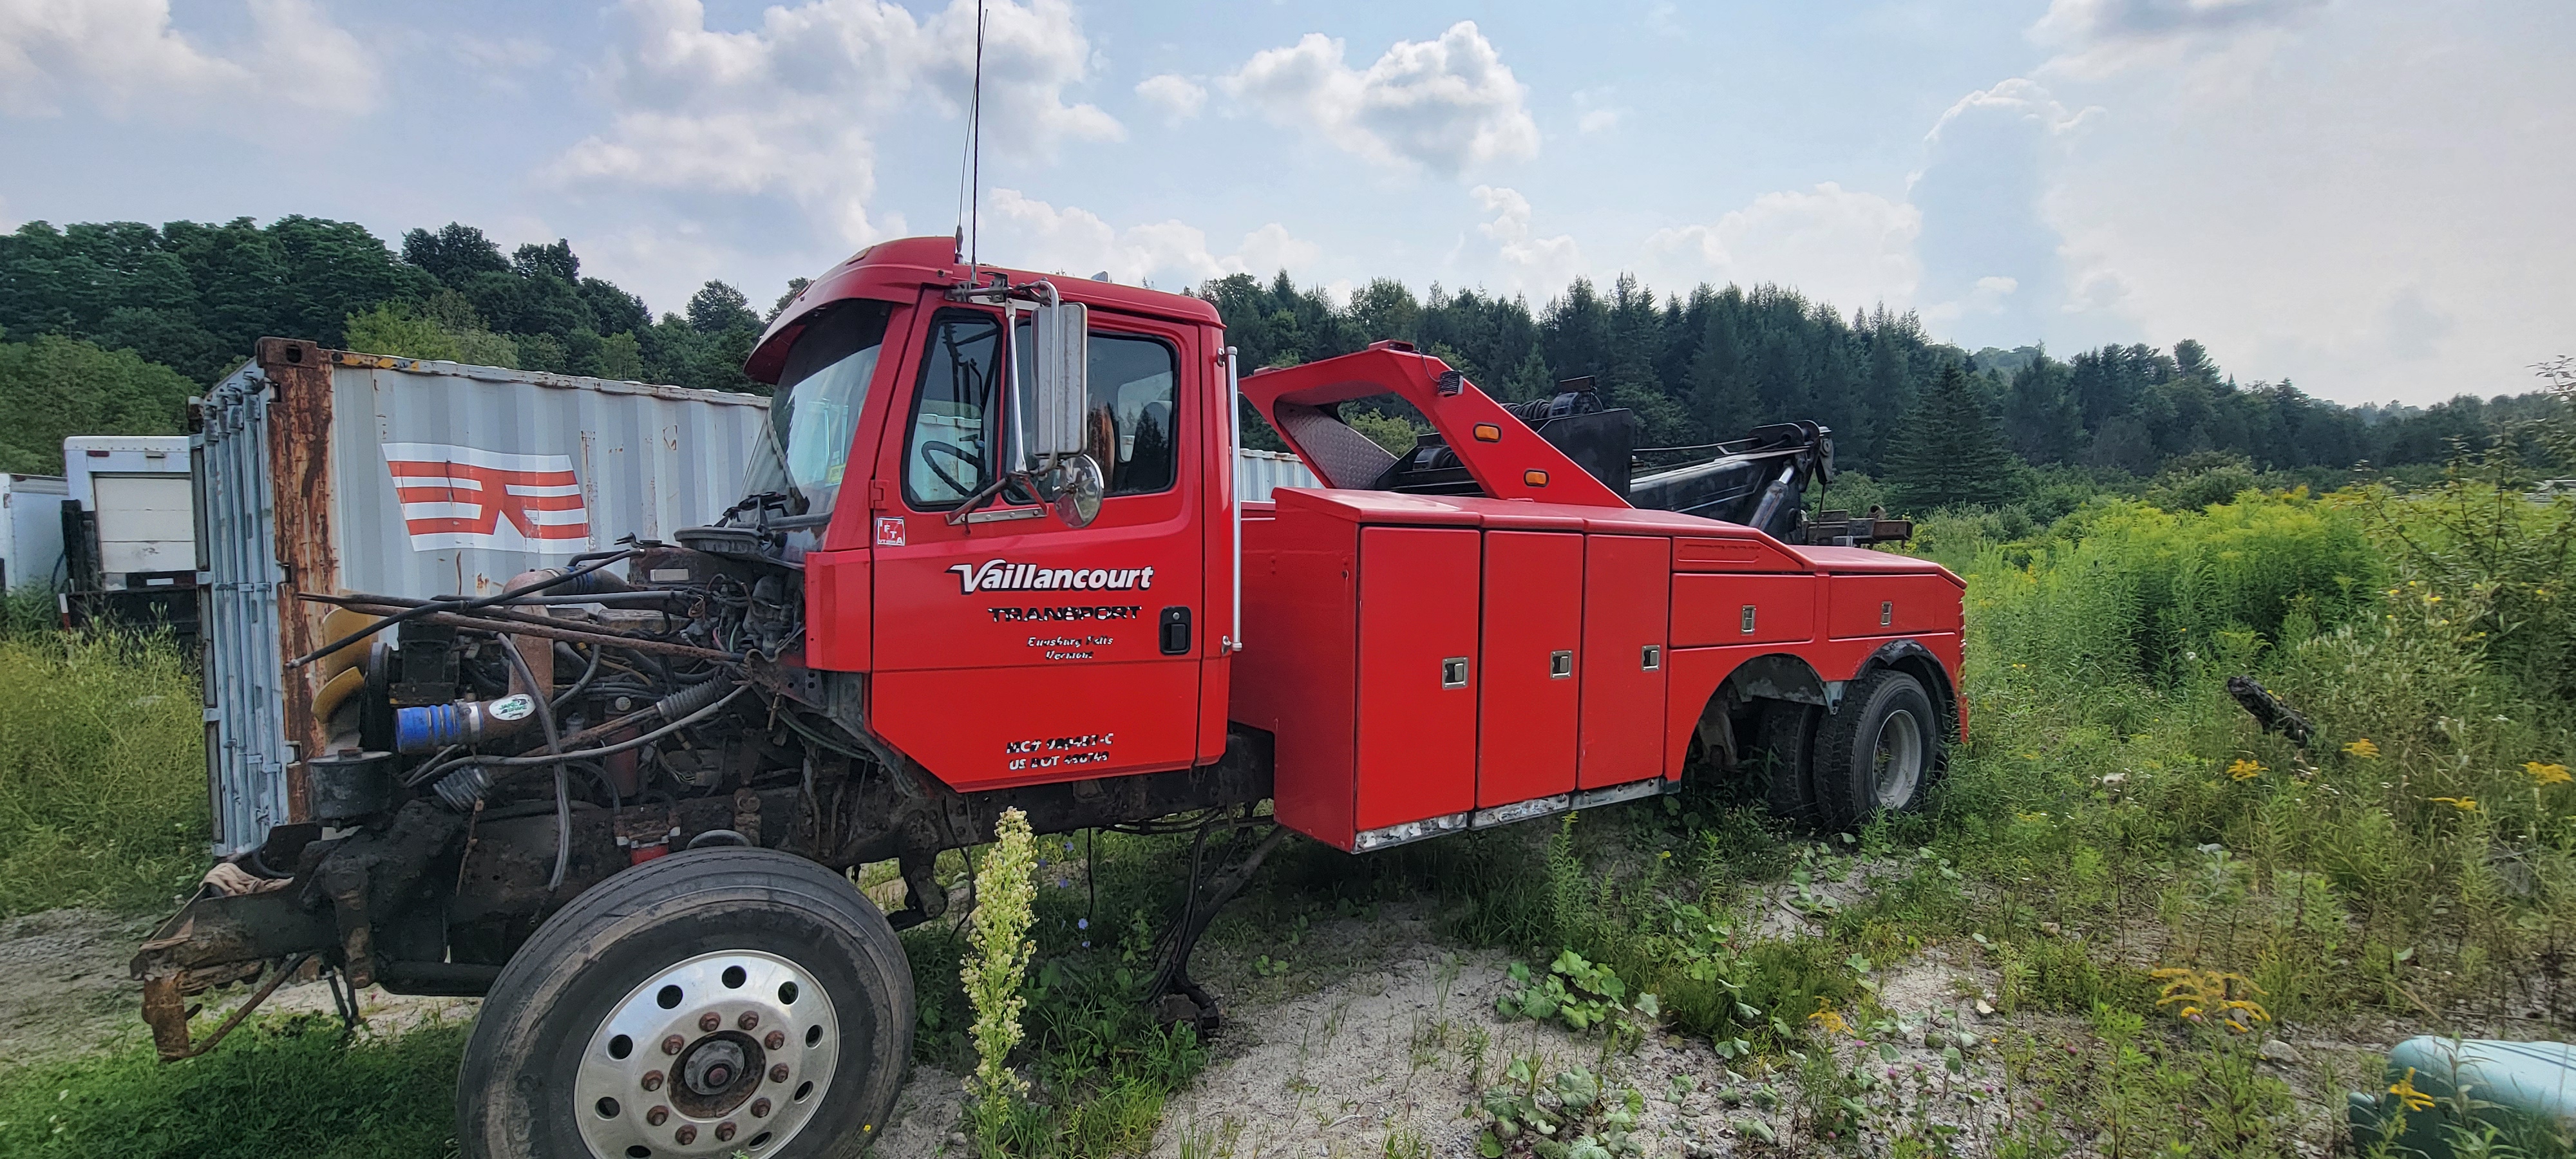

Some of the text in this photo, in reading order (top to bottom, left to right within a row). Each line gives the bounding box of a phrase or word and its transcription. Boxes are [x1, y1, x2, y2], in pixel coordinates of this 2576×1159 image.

[945, 559, 1154, 594] Vaillancourt
[988, 606, 1142, 622] TRANSPORT
[1045, 650, 1094, 660] Vermont
[1006, 740, 1041, 753] MC#
[1009, 759, 1027, 770] US
[1031, 755, 1060, 769] DOT
